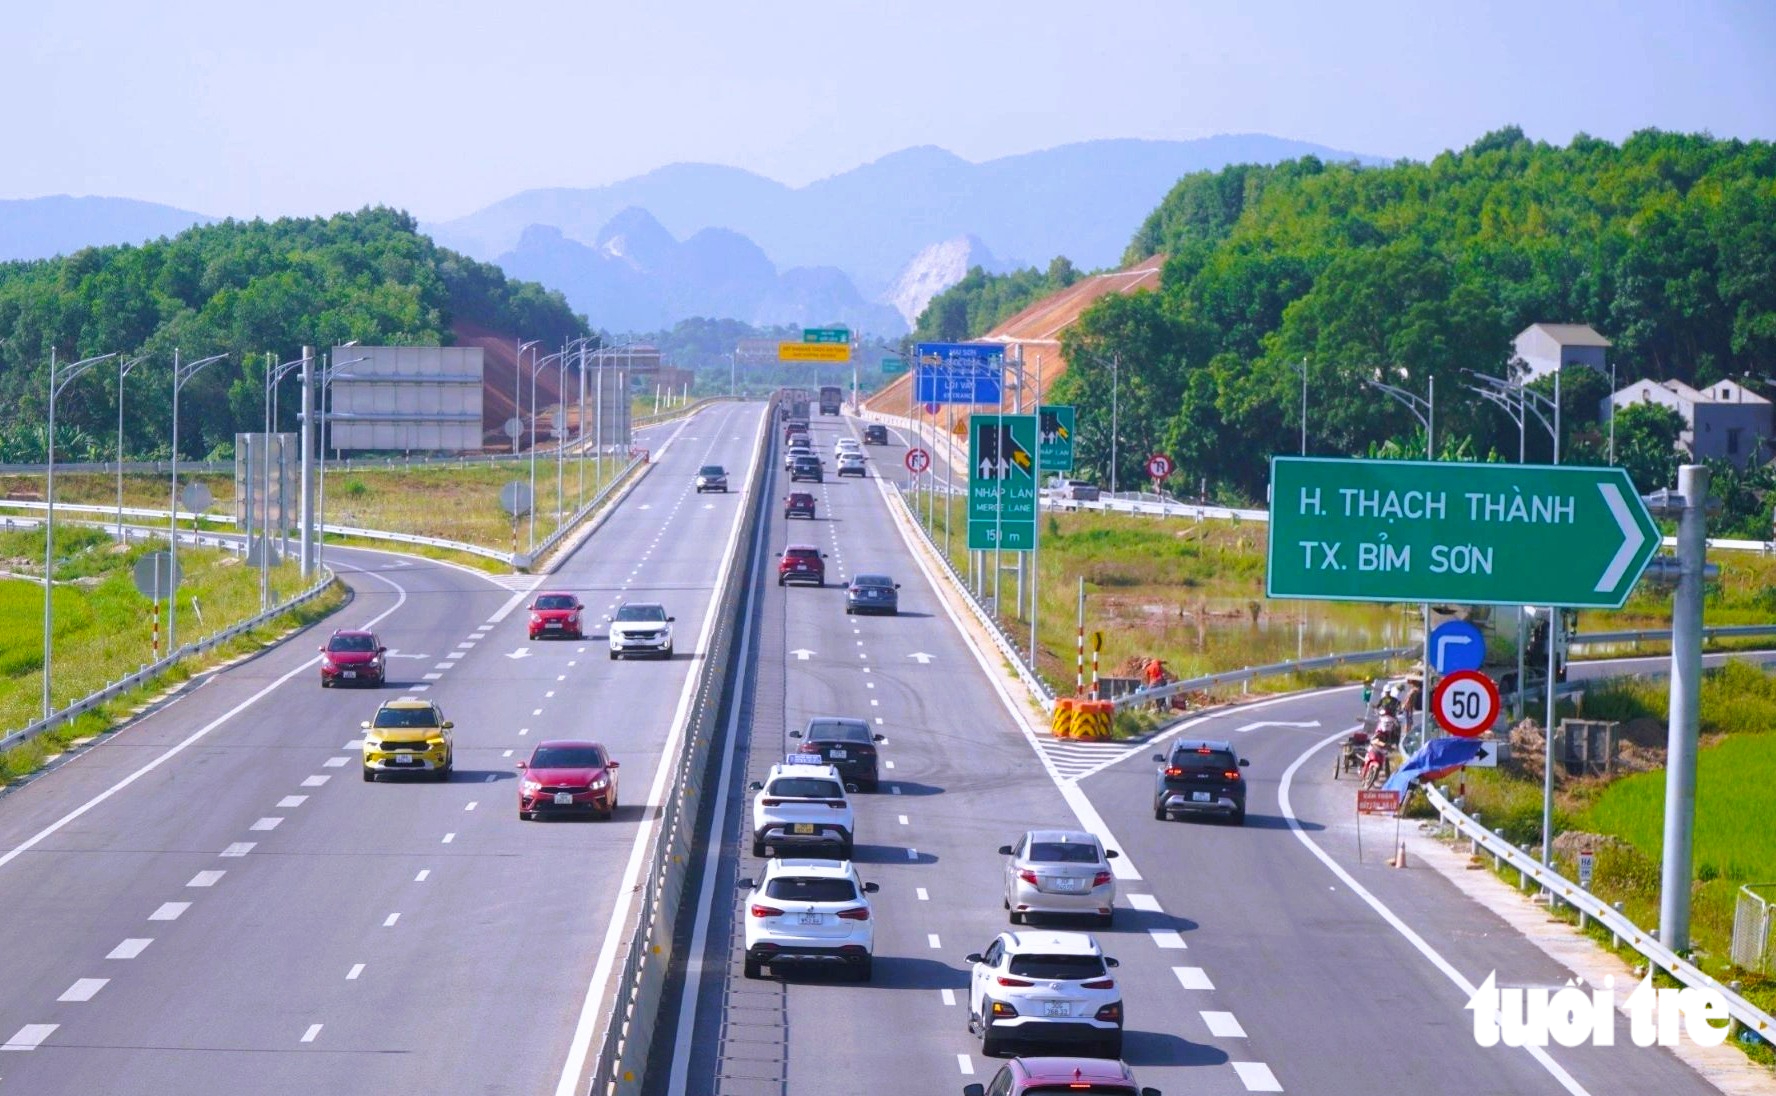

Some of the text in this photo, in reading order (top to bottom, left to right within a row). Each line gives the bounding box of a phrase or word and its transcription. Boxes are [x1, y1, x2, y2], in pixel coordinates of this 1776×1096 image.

[1008, 504, 1032, 513] LANE
[1300, 485, 1575, 525] H. THẠCH THÀNH
[1009, 532, 1020, 543] m
[1299, 533, 1494, 575] TX. BỈM SƠN
[1452, 691, 1481, 720] 50
